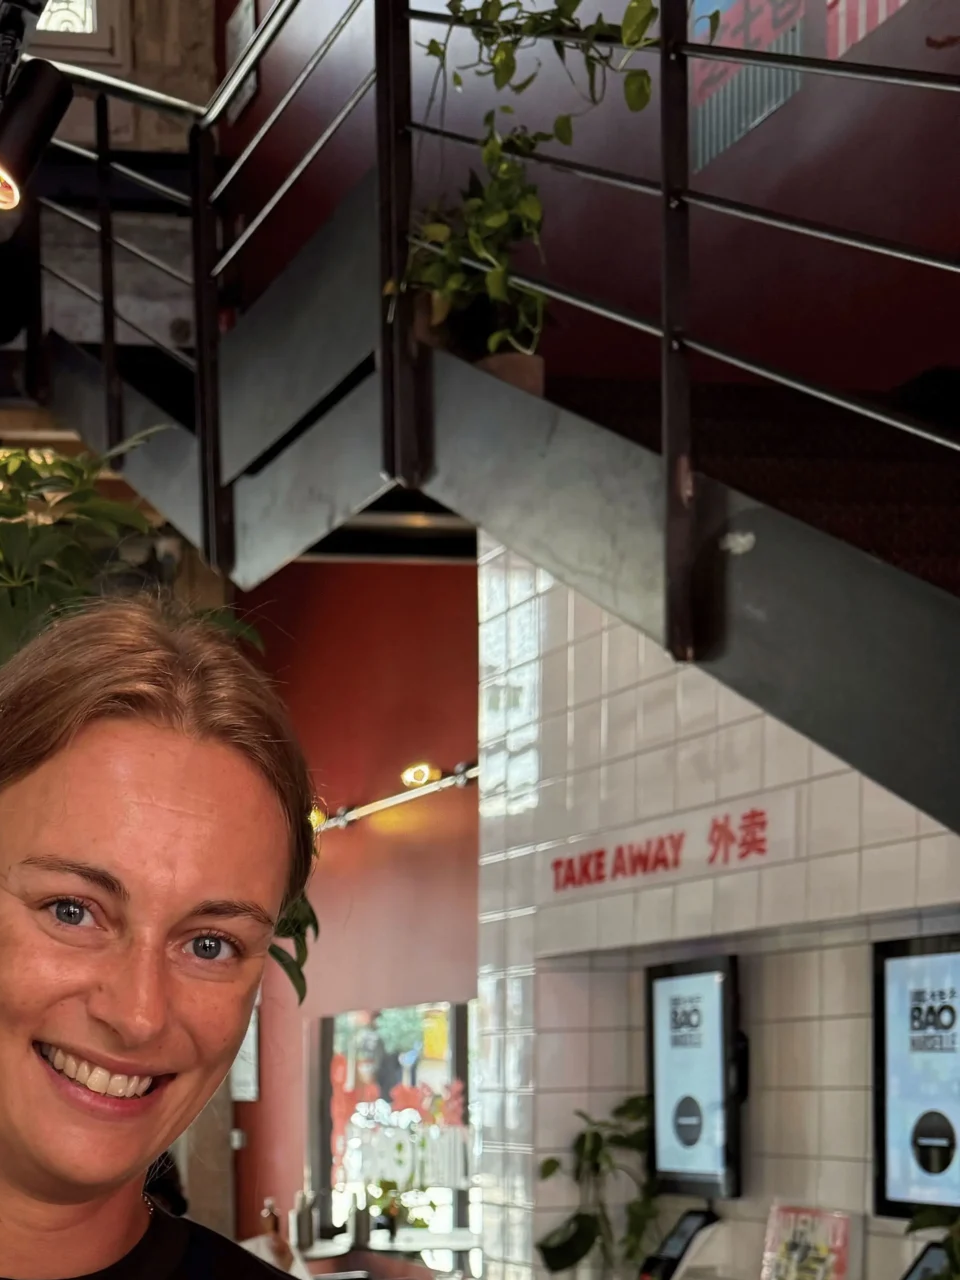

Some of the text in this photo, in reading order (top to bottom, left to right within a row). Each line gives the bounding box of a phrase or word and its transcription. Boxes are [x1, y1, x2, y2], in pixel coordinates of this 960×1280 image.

[551, 829, 686, 893] TAKE AWAY
[706, 807, 769, 866] 外卖
[909, 1003, 958, 1032] BAO
